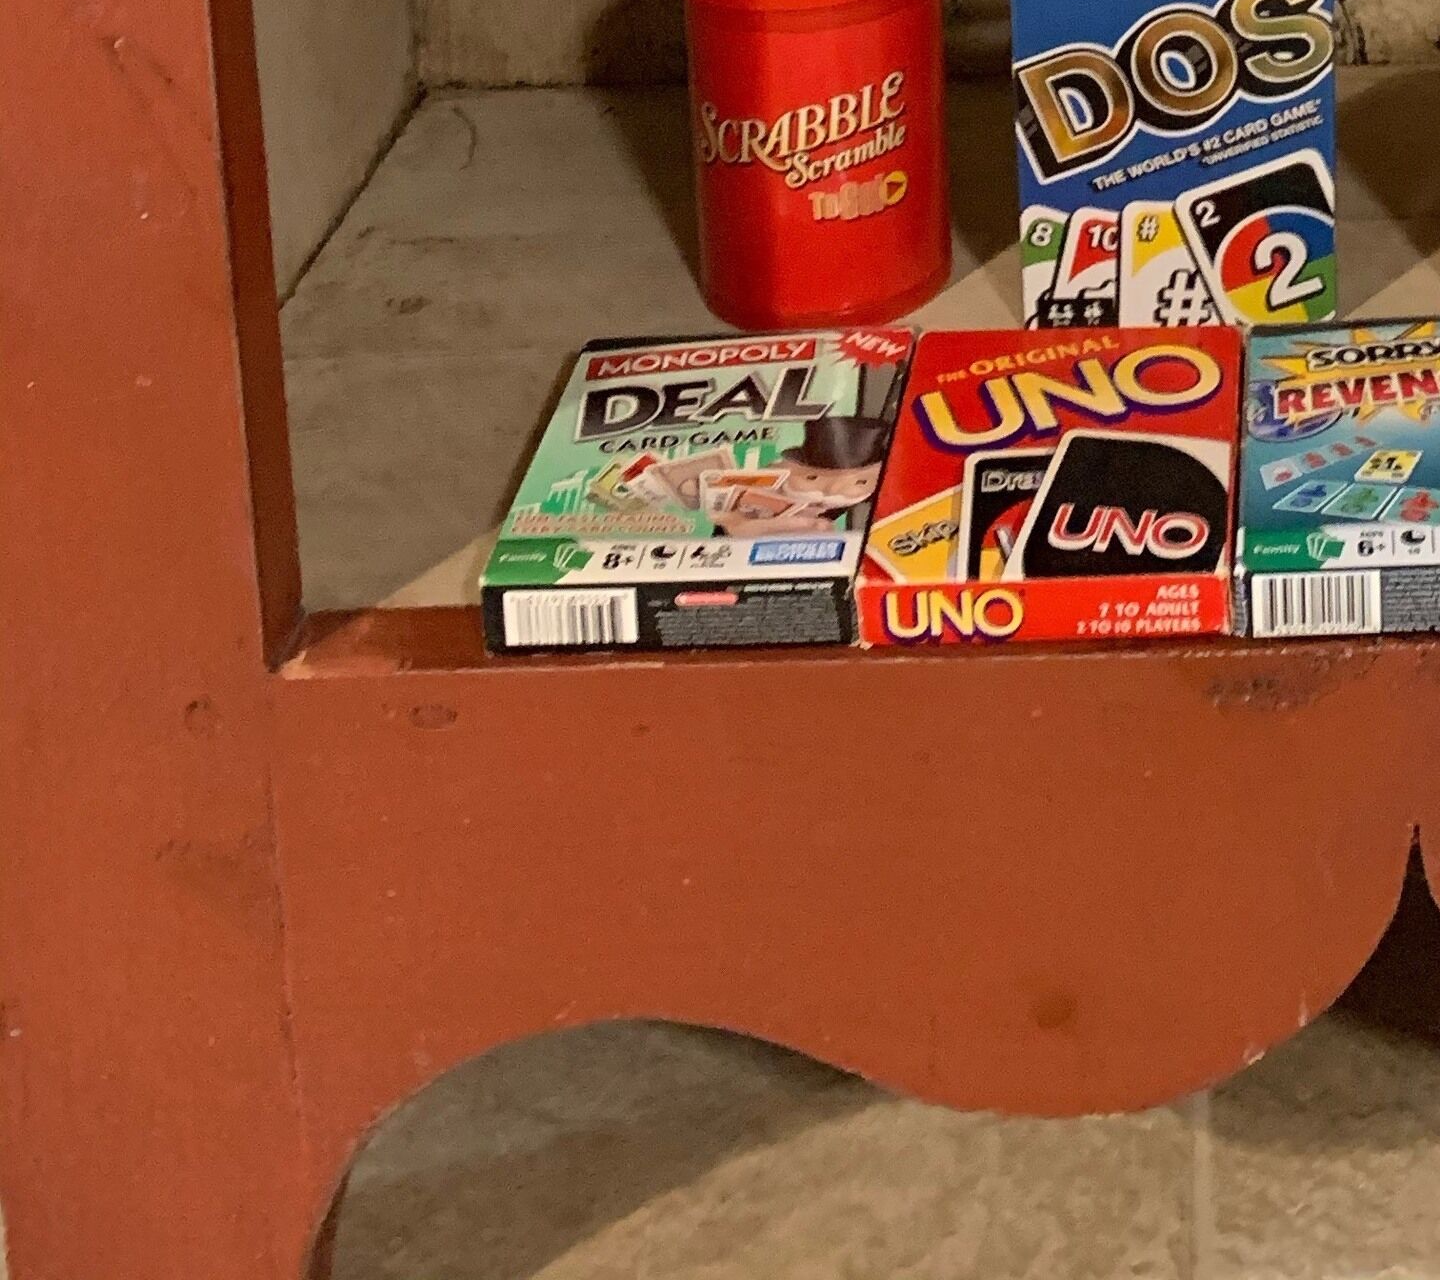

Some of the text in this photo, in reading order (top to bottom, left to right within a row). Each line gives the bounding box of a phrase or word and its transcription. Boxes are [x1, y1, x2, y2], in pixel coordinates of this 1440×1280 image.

[700, 71, 905, 173] SCRABBLE
[784, 122, 907, 189] Scramble
[1091, 169, 1128, 191] THE
[1128, 141, 1201, 177] WORLD'S
[1202, 132, 1222, 153] #2
[1222, 118, 1269, 143] CARD
[1031, 222, 1054, 247] 8
[1194, 199, 1221, 229] 2
[1253, 231, 1325, 311] 2
[597, 338, 811, 377] MONOPOLY
[845, 330, 908, 361] NEW
[938, 334, 1122, 385] THE ORIGINAL
[574, 364, 833, 443] DEAL
[917, 343, 1223, 450] UNO
[599, 425, 777, 455] CARD GAME
[1046, 502, 1211, 560] UNO
[884, 587, 1025, 640] UNO
[1114, 601, 1140, 618] TO
[1145, 600, 1200, 618] ADULT
[1155, 583, 1200, 601] AGES
[1088, 619, 1112, 635] TO
[1134, 617, 1201, 634] PLAYERS
